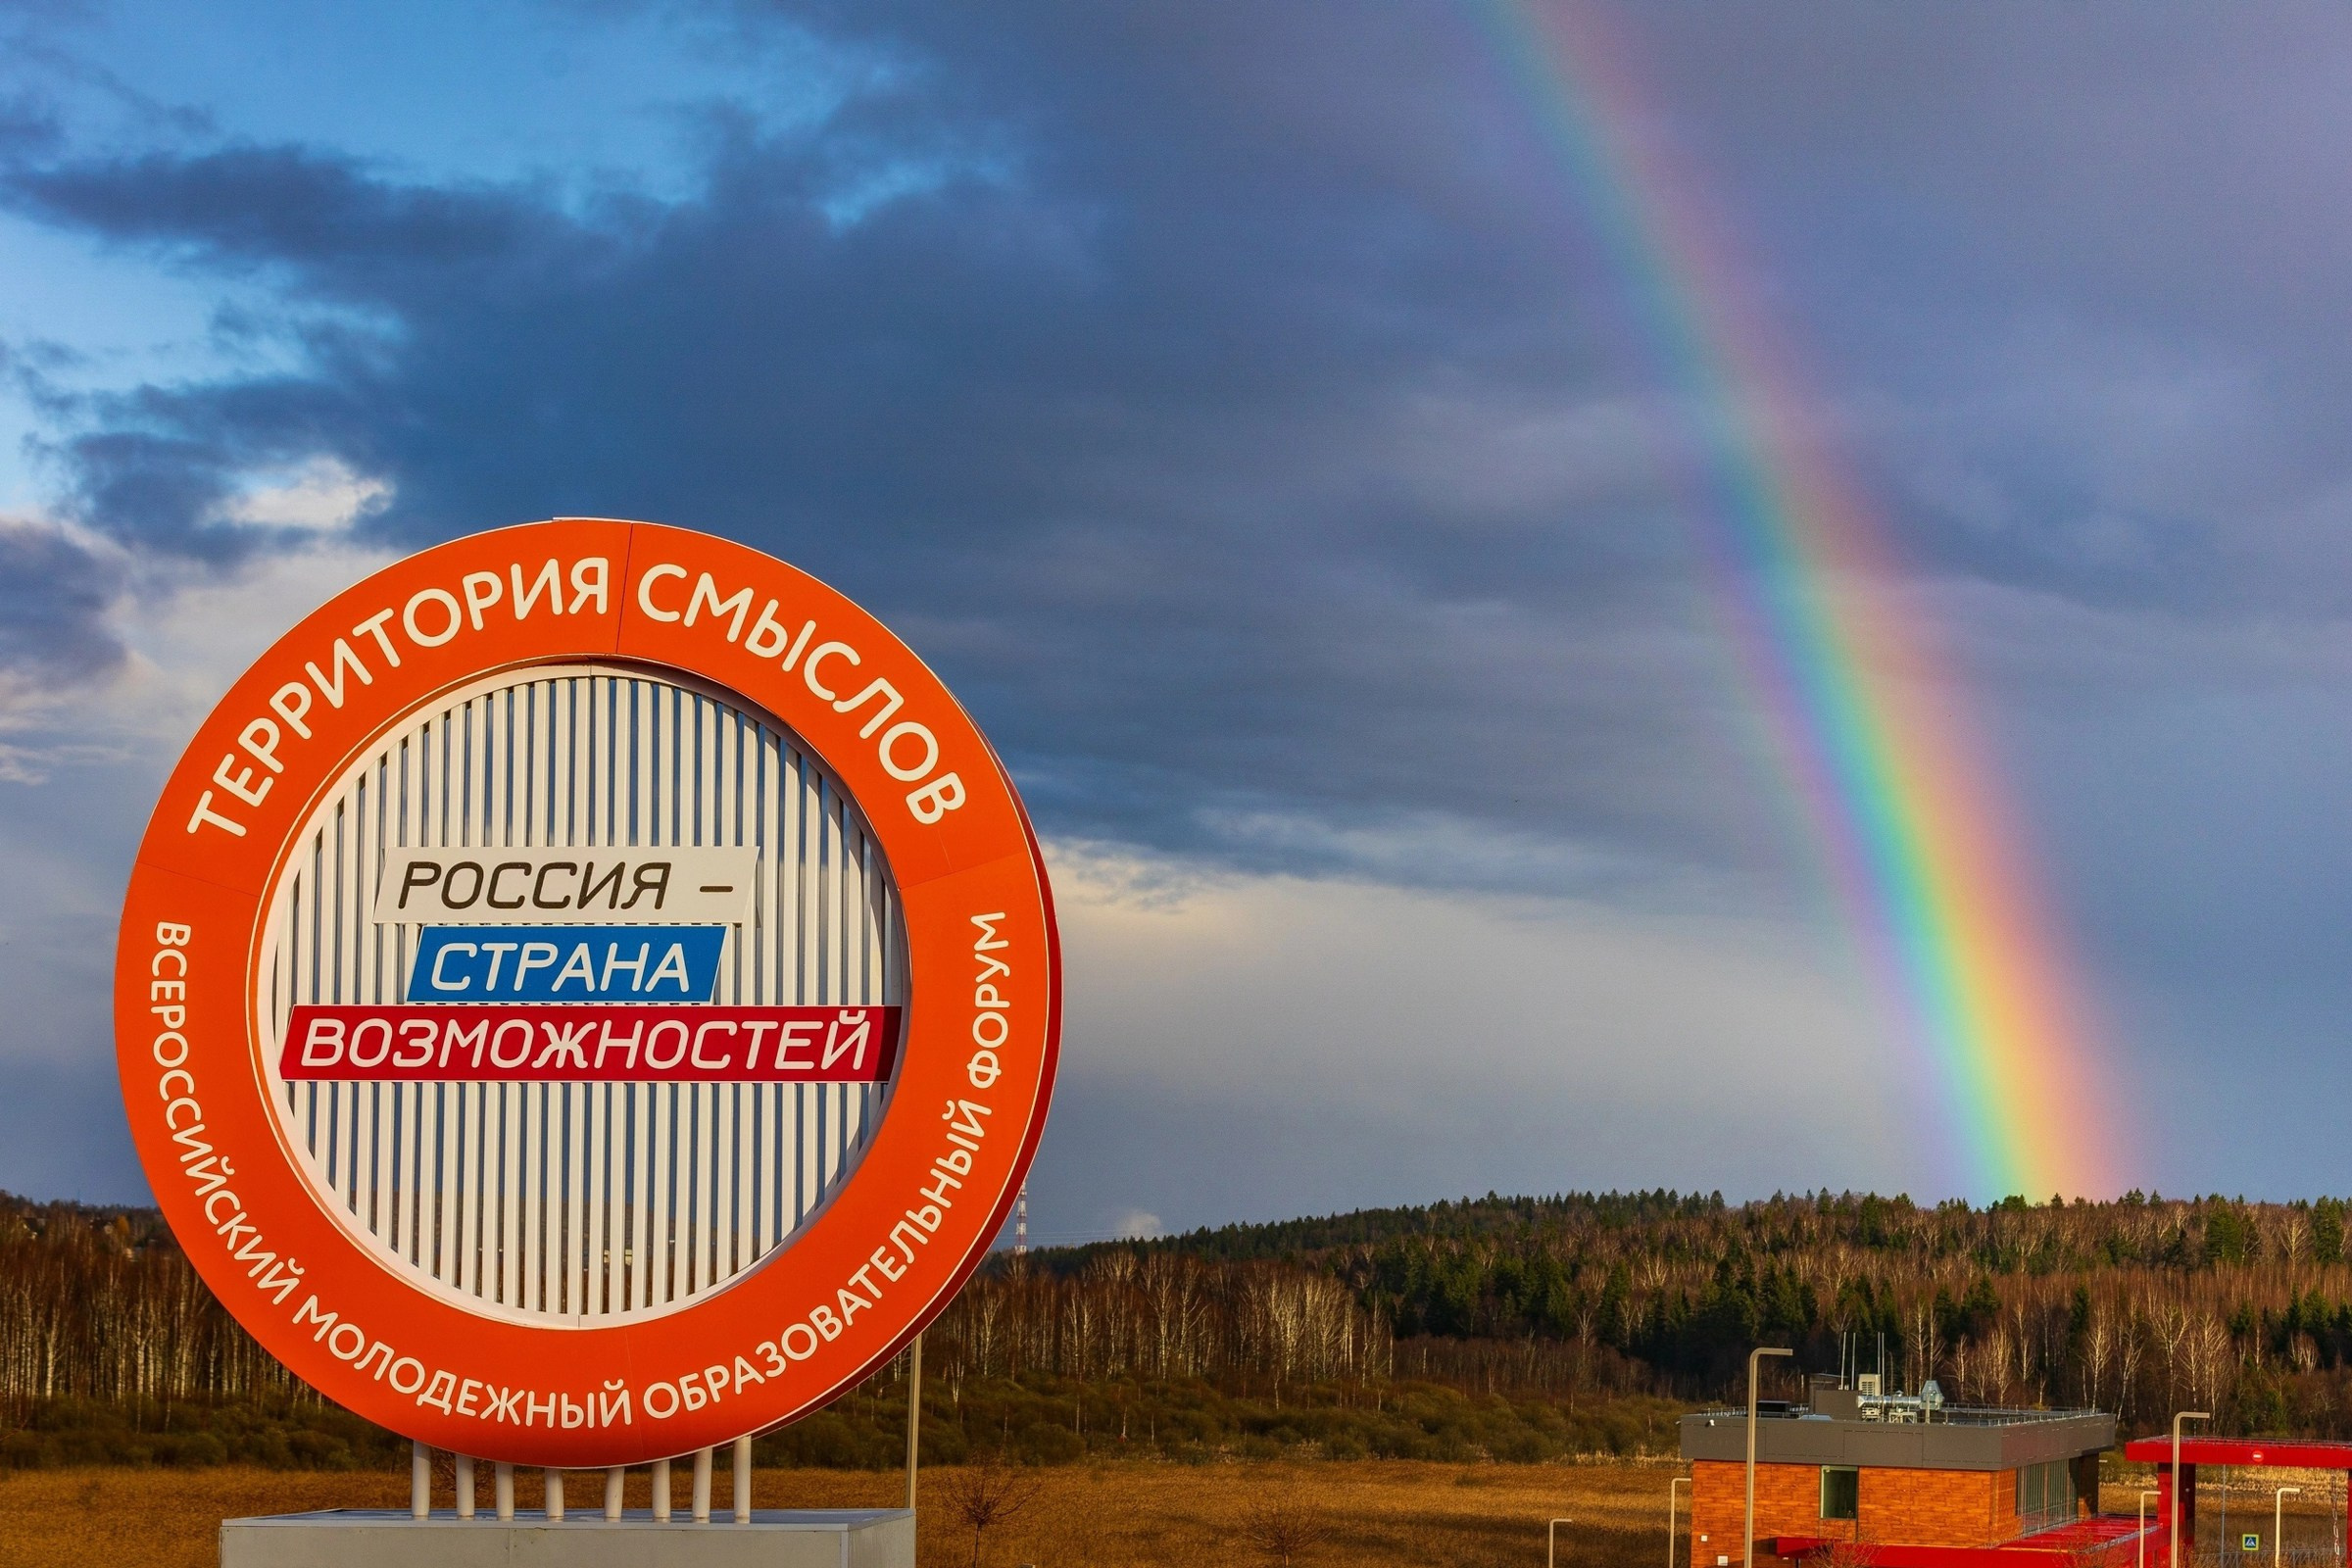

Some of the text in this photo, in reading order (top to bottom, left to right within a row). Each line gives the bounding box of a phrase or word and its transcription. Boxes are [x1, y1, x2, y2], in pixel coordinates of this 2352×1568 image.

[186, 557, 966, 837] ТЕРРИТОРИЯ СМЫСЛОВ
[398, 860, 671, 910] РОССИЯ
[431, 942, 690, 993] СТРАНА
[301, 1009, 871, 1070] ВОЗМОЖНОСТЕЙ
[150, 911, 1010, 1429] ВСЕРОССИЙСКИЙ МОЛОДЕЖНЫЙ ОБРАЗОВАТЕЛЬНЫЙ ФОРУМ
